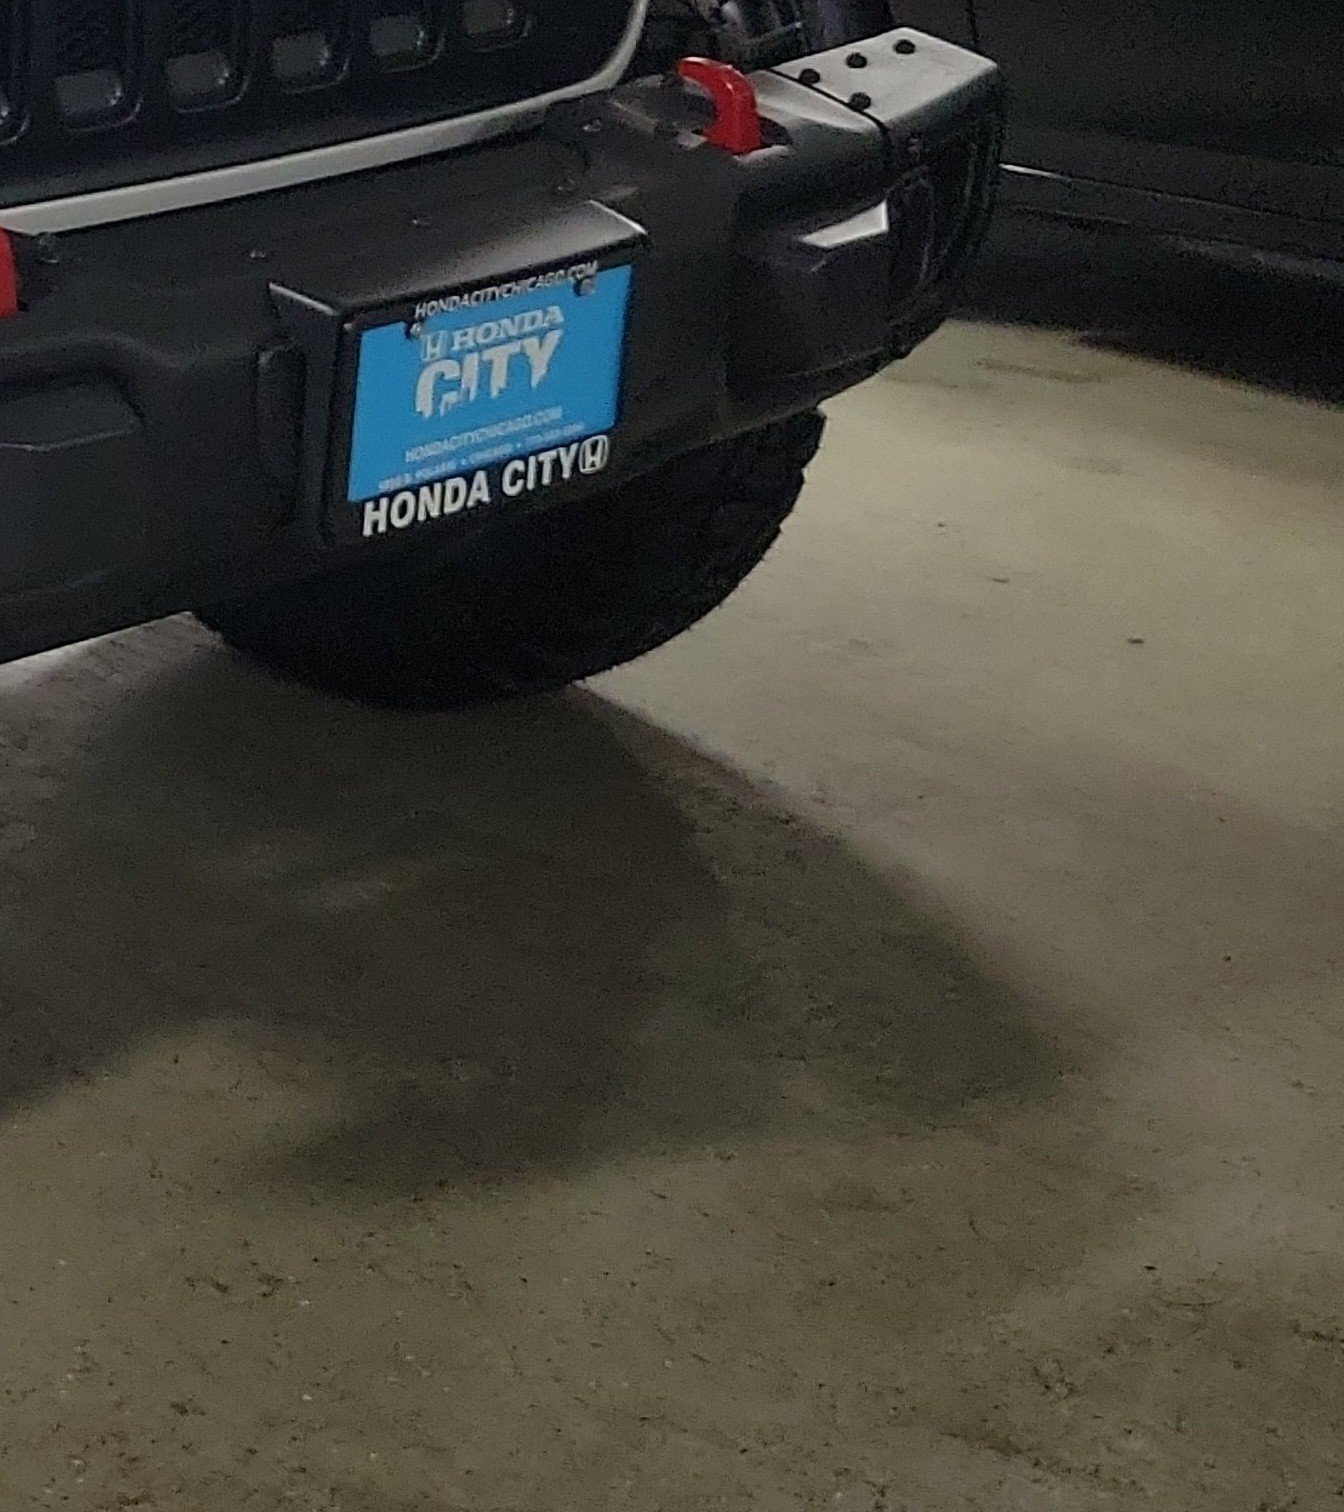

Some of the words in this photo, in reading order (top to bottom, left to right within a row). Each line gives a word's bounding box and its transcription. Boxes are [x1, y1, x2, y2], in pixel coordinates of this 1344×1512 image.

[450, 305, 565, 351] HONDA
[414, 329, 564, 419] CITY
[362, 471, 491, 537] HONDA
[501, 442, 580, 498] CITY
